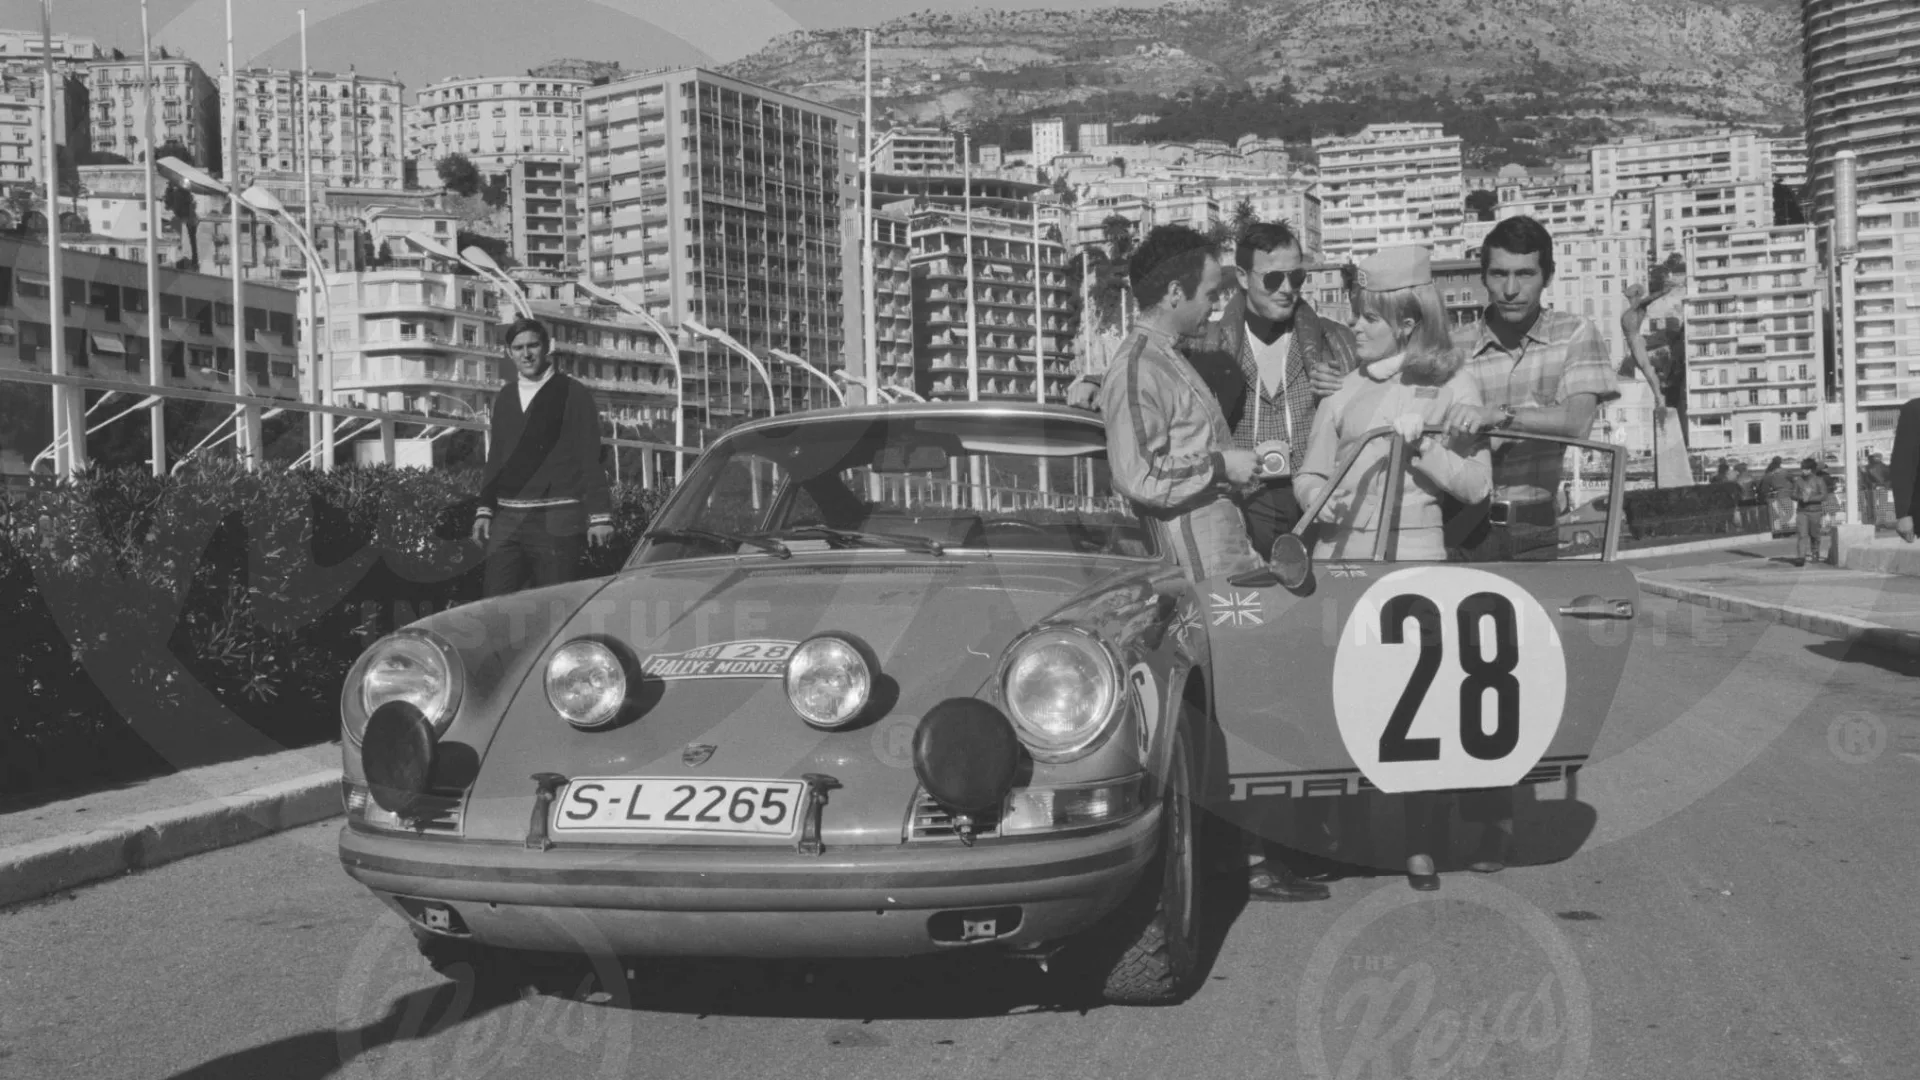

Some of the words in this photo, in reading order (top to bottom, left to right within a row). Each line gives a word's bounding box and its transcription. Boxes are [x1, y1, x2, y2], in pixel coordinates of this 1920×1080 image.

[733, 644, 789, 658] 28
[646, 658, 715, 676] RALLYE
[1378, 590, 1520, 763] 28
[664, 784, 789, 826] 2265
